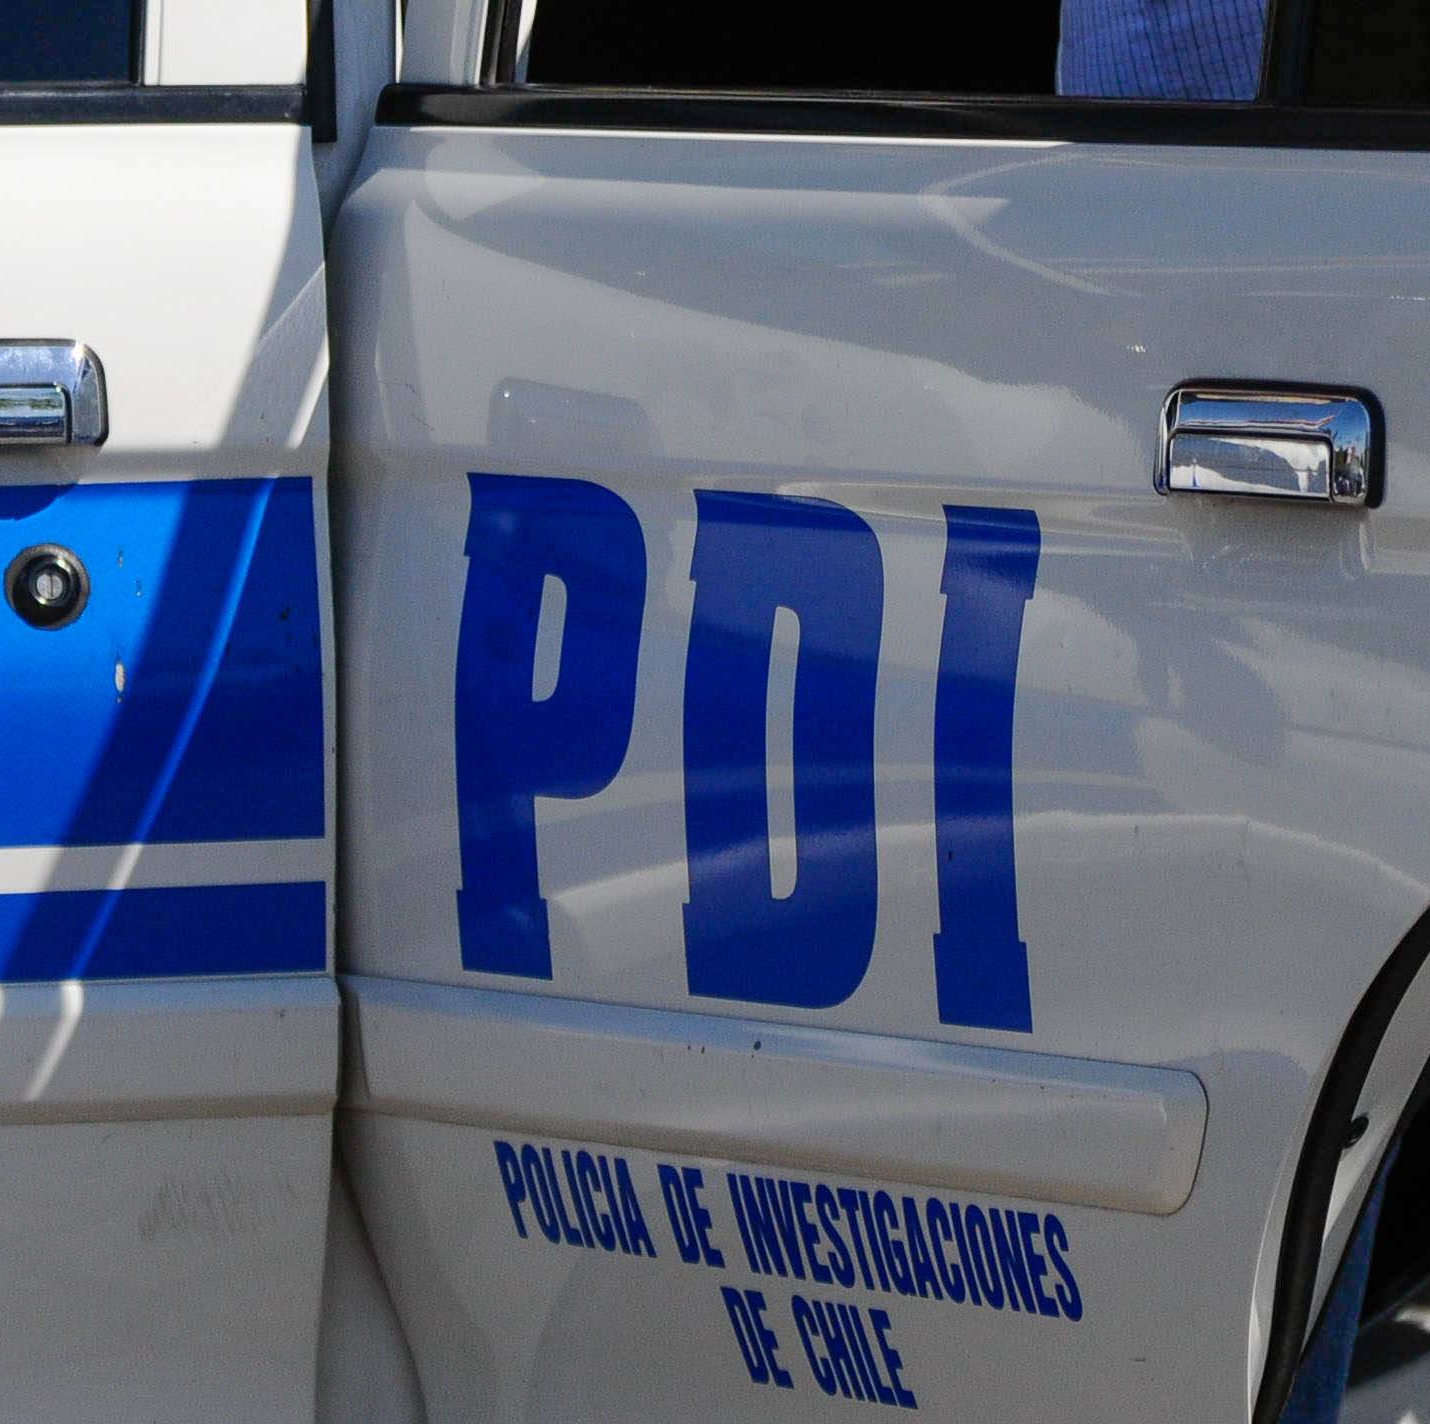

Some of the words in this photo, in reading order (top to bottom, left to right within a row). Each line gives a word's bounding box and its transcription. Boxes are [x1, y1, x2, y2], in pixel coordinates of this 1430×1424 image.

[455, 472, 1042, 1034] PDI
[493, 1140, 657, 1258] POLICIA
[657, 1163, 726, 1269] DE
[726, 1172, 1083, 1322] INVESTIGACIONES
[720, 1285, 795, 1390] DE
[791, 1293, 919, 1410] CHILE
